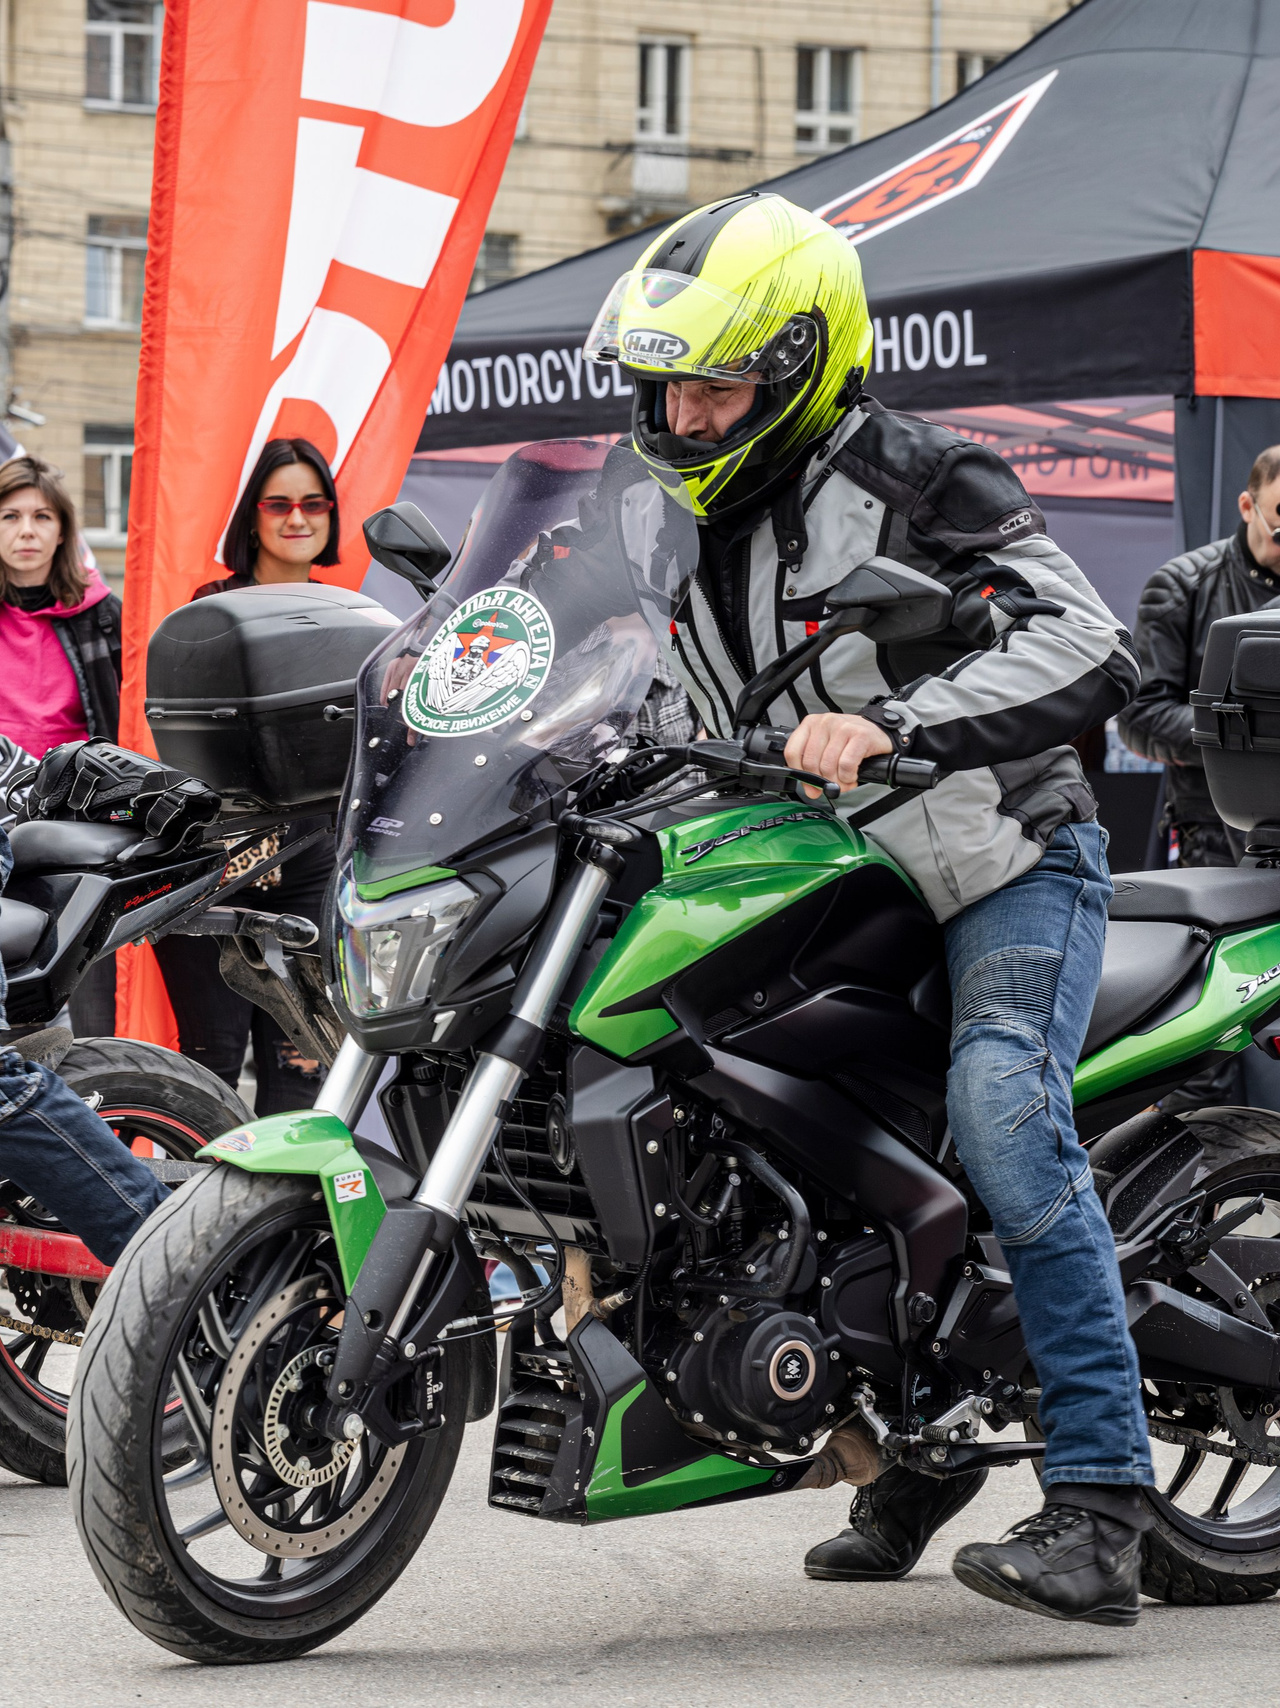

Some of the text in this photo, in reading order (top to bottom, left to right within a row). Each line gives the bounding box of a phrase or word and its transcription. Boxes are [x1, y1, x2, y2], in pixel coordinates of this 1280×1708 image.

[426, 309, 987, 415] MOTORCYCL HOOL
[627, 334, 680, 356] HJC
[1001, 513, 1031, 533] MCP
[425, 591, 550, 669] КРЫЛЬЯ АНГЕЛА
[450, 694, 522, 732] ДВИЖЕНИЕ
[679, 811, 835, 866] DOMINA
[1236, 962, 1280, 1004] D40
[335, 1172, 363, 1182] SUPER
[426, 1371, 434, 1411] BYBRE
